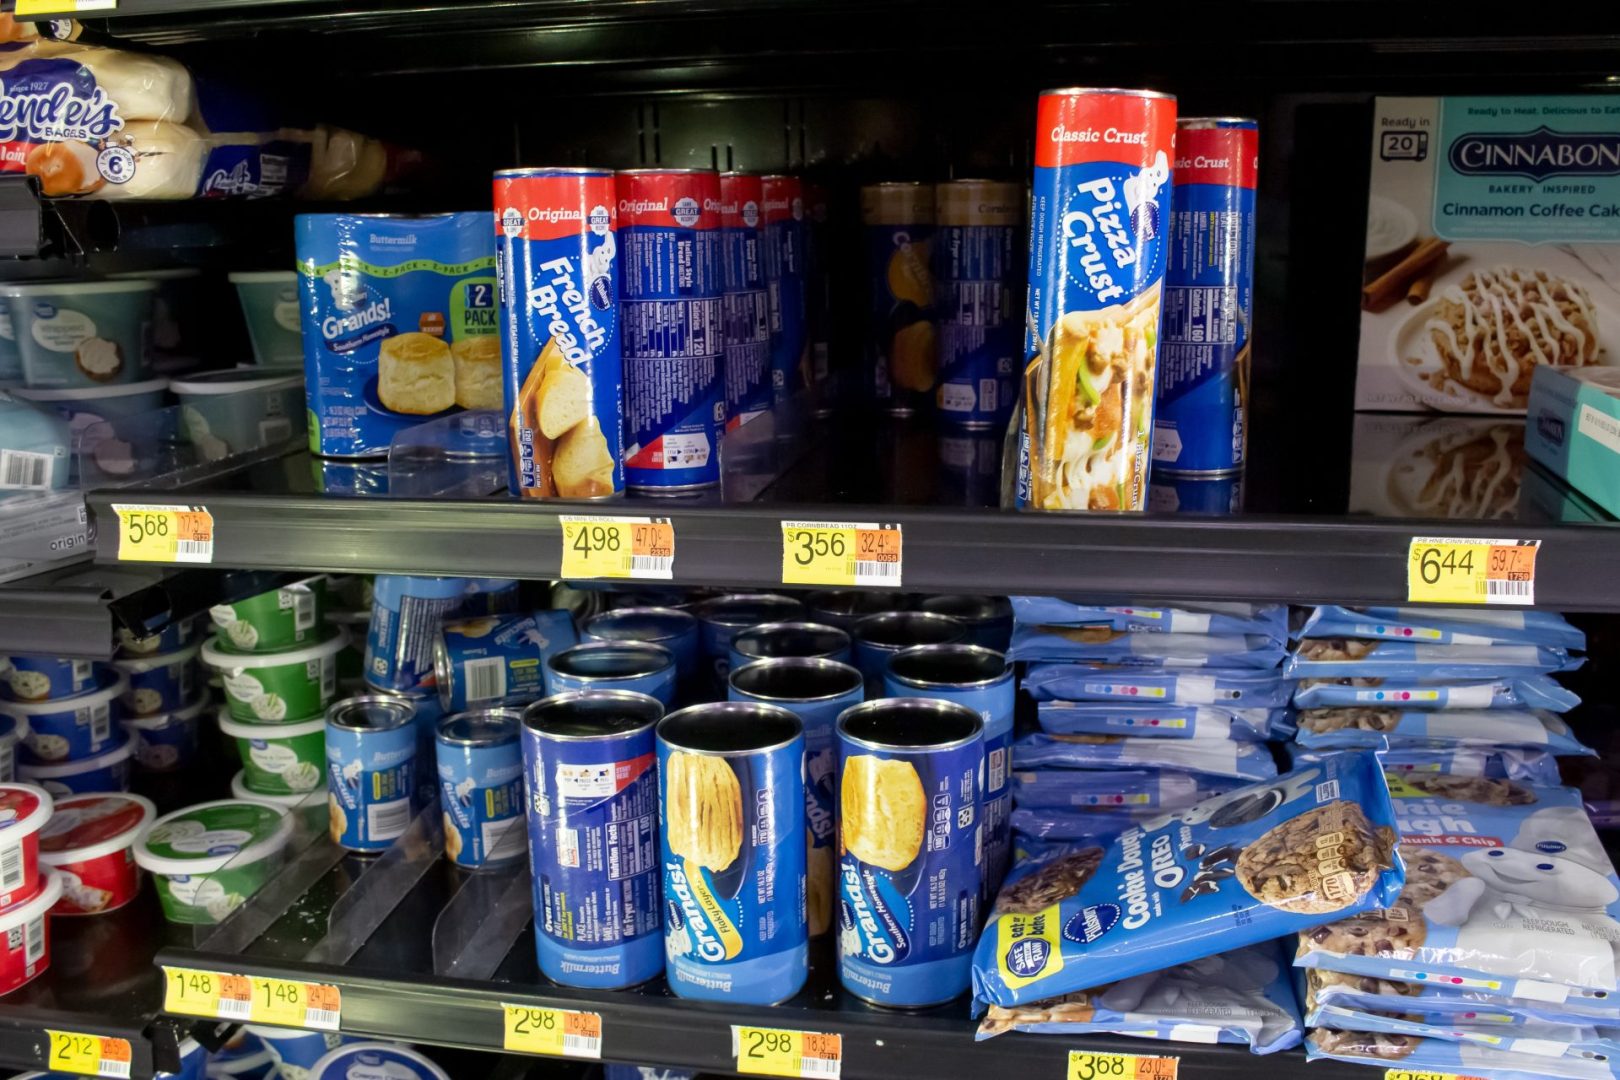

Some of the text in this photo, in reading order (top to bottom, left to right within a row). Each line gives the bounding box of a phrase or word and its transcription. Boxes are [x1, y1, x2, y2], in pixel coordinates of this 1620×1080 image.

[30, 82, 49, 92] 1927
[0, 82, 121, 137] ender's
[1468, 106, 1498, 117] Ready
[1501, 107, 1512, 115] to
[1542, 106, 1588, 115] Delicious
[1590, 106, 1602, 115] to
[45, 127, 87, 139] BAGELS
[1381, 117, 1430, 129] Ready in
[1051, 126, 1147, 145] Classic Crust
[1388, 137, 1413, 151] 20
[1, 146, 27, 166] lain
[108, 156, 123, 175] 6
[1194, 155, 1229, 169] Crust
[1460, 140, 1620, 168] CINNABON
[1488, 185, 1596, 195] BAKERY INSPIRED
[528, 207, 584, 224] Original
[619, 197, 669, 214] Original
[675, 208, 698, 217] GREAT
[1443, 203, 1620, 218] Cinnamon Coffee Cak
[590, 217, 611, 225] GREAT
[1038, 212, 1046, 233] DOUGH
[1077, 177, 1137, 269] Pizza
[370, 233, 418, 244] Buttermilk
[678, 241, 686, 264] Bread
[684, 240, 693, 288] Italian Style
[1036, 233, 1045, 277] REFRIGERATED
[1062, 210, 1125, 303] Crust
[474, 284, 488, 307] 2
[539, 256, 606, 352] French
[322, 297, 391, 340] Grands!
[464, 309, 497, 326] PACK
[526, 284, 594, 368] Bread
[1191, 289, 1205, 342] Calories 160
[692, 301, 705, 356] Calories 120
[1131, 474, 1142, 506] Crust
[796, 522, 840, 530] CORNBREAD
[331, 763, 358, 811] Biscuits
[444, 782, 471, 830] Biscuits
[608, 824, 620, 878] Nutrition Facts
[1399, 836, 1443, 846] hunk
[1461, 837, 1498, 848] Chip
[1151, 834, 1185, 889] OREO
[1113, 826, 1151, 931] Cookie Dough
[1324, 878, 1342, 898] 170
[665, 862, 726, 963] Grands!
[841, 862, 895, 965] Grands!
[862, 868, 907, 950] Southern Homestyle
[928, 900, 938, 910] NET
[544, 906, 553, 932] Oven
[622, 902, 636, 937] Air Fryer
[711, 908, 731, 936] Flaky
[1026, 914, 1046, 936] bake
[1081, 907, 1104, 942] Pillsbury
[575, 922, 587, 942] PLACE
[602, 927, 613, 942] BAKE
[957, 921, 967, 949] Oven
[1010, 923, 1025, 939] eat
[1013, 946, 1026, 971] SAFE
[1031, 941, 1044, 962] RAW
[561, 962, 621, 975] Buttermilk
[675, 967, 733, 993] Buttermilk
